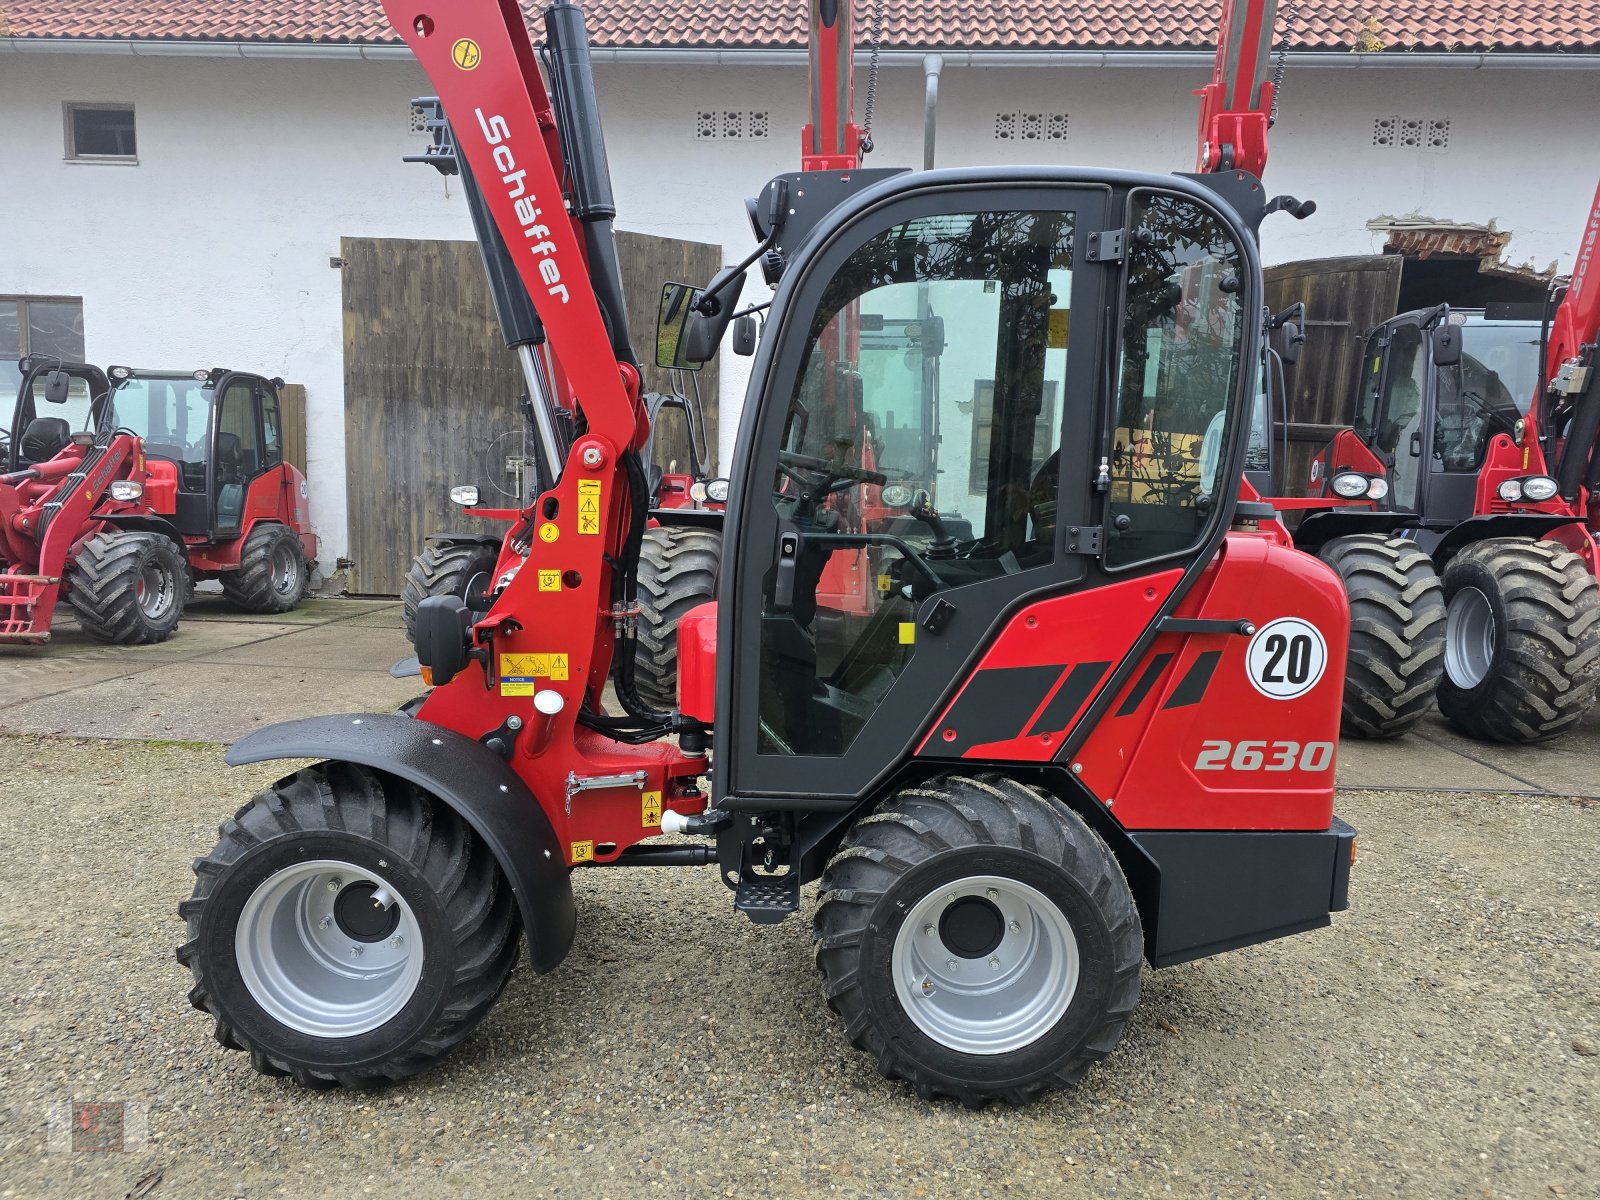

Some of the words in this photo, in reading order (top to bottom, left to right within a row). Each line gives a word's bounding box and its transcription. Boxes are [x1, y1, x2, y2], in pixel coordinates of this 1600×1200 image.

[475, 108, 570, 304] Schäffer
[1261, 634, 1312, 684] 20
[1194, 740, 1335, 772] 2630
